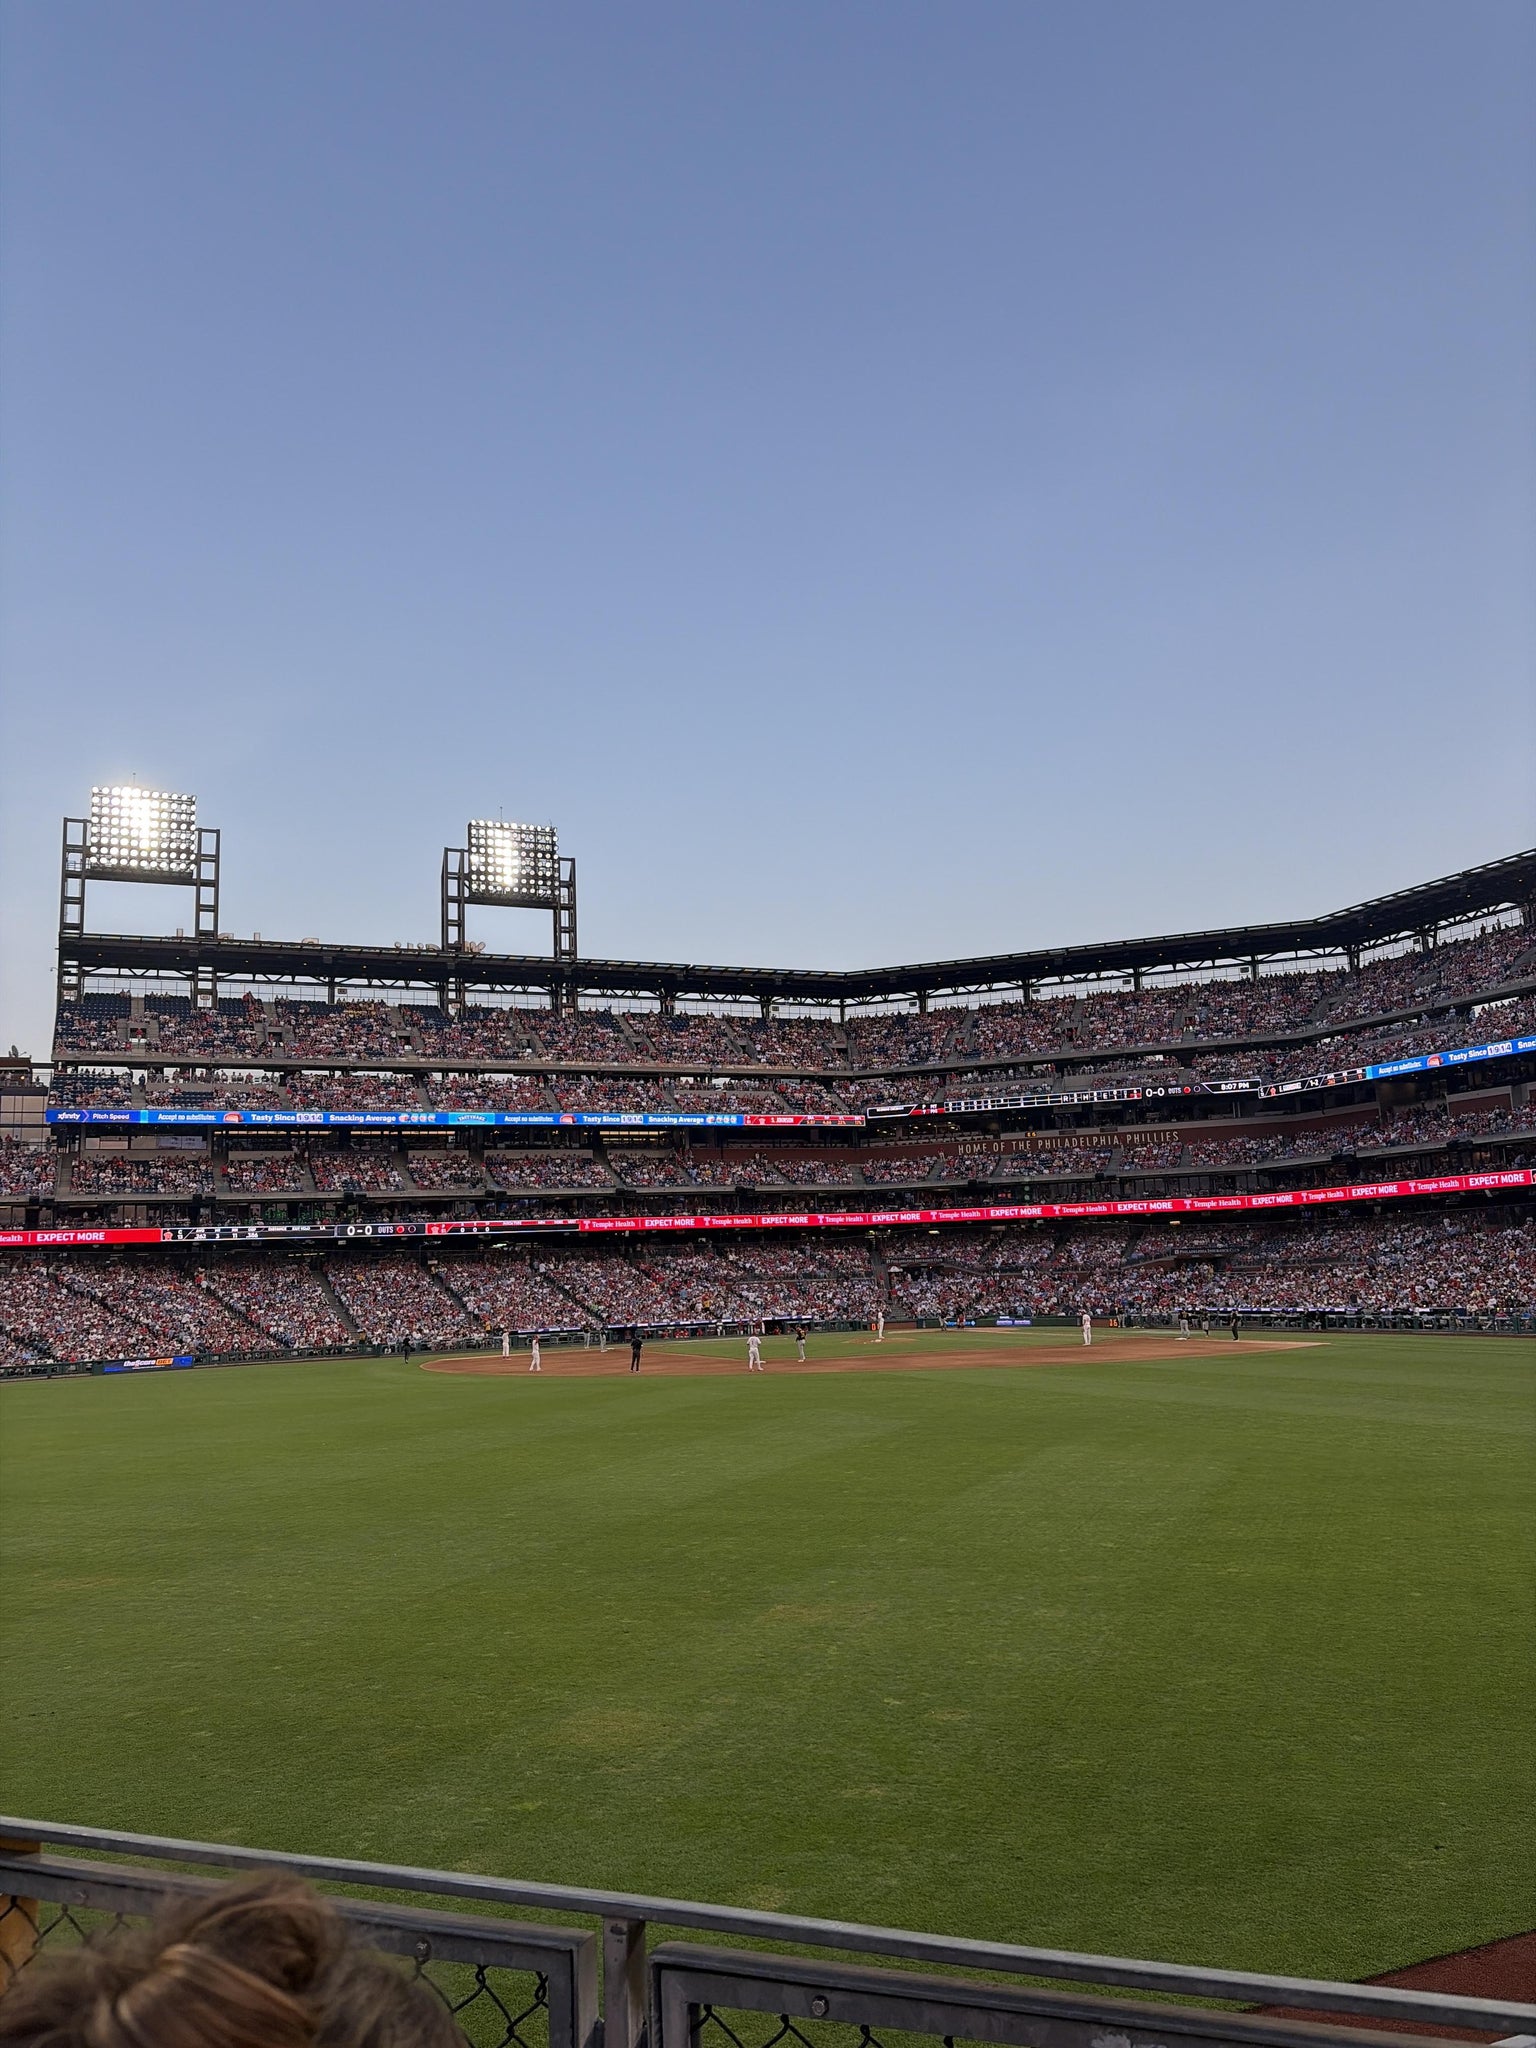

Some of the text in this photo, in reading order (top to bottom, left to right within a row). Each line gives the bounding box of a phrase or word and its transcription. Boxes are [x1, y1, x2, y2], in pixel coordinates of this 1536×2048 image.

[1449, 1042, 1513, 1062] Tasty Since 1914
[1145, 1087, 1165, 1097] 0-0
[1221, 1083, 1237, 1091] 8:07
[1063, 1095, 1069, 1103] R
[1102, 1092, 1108, 1100] E
[57, 1112, 81, 1120] xfinity
[92, 1112, 130, 1121] Pitch Speed
[157, 1113, 178, 1121] Accept
[251, 1113, 324, 1122] Tasty Since 1914
[329, 1113, 397, 1123] Snacking Average
[504, 1115, 521, 1123] Accept
[583, 1115, 601, 1124] Tasty
[621, 1115, 644, 1124] 1914
[648, 1116, 704, 1124] Snacking Average
[958, 1131, 1180, 1155] HOME OF THE PHILADELPHIA PHILLIES
[1416, 1181, 1439, 1191] Temple
[1439, 1179, 1460, 1188] Health
[1469, 1175, 1499, 1187] EXPECT
[1501, 1173, 1525, 1184] MORE
[1308, 1192, 1327, 1201] Temple
[1327, 1190, 1344, 1199] Health
[1352, 1186, 1378, 1197] EXPECT
[1378, 1184, 1398, 1194] MORE
[1193, 1200, 1217, 1209] Temple
[1218, 1198, 1242, 1207] Health
[1252, 1196, 1275, 1206] EXPECT
[1276, 1194, 1293, 1204] MORE
[1062, 1205, 1084, 1214] Temple
[1085, 1204, 1107, 1212] Health
[1117, 1202, 1147, 1211] EXPECT
[1149, 1201, 1173, 1210] MORE
[825, 1216, 845, 1224] Temple
[872, 1214, 899, 1222] EXPECT
[900, 1212, 921, 1221] MORE
[939, 1212, 960, 1220] Temple
[960, 1210, 981, 1218] Health
[990, 1208, 1019, 1217] EXPECT
[1020, 1207, 1042, 1216] MORE
[592, 1220, 614, 1229] Temple
[615, 1219, 636, 1227] Health
[645, 1218, 673, 1227] EXPECT
[674, 1218, 695, 1226] MORE
[711, 1218, 732, 1226] Temple
[761, 1216, 788, 1224] EXPECT
[788, 1216, 808, 1224] MORE
[377, 1226, 394, 1234] OUTS
[36, 1232, 75, 1242] EXPECT
[77, 1231, 106, 1241] MORE
